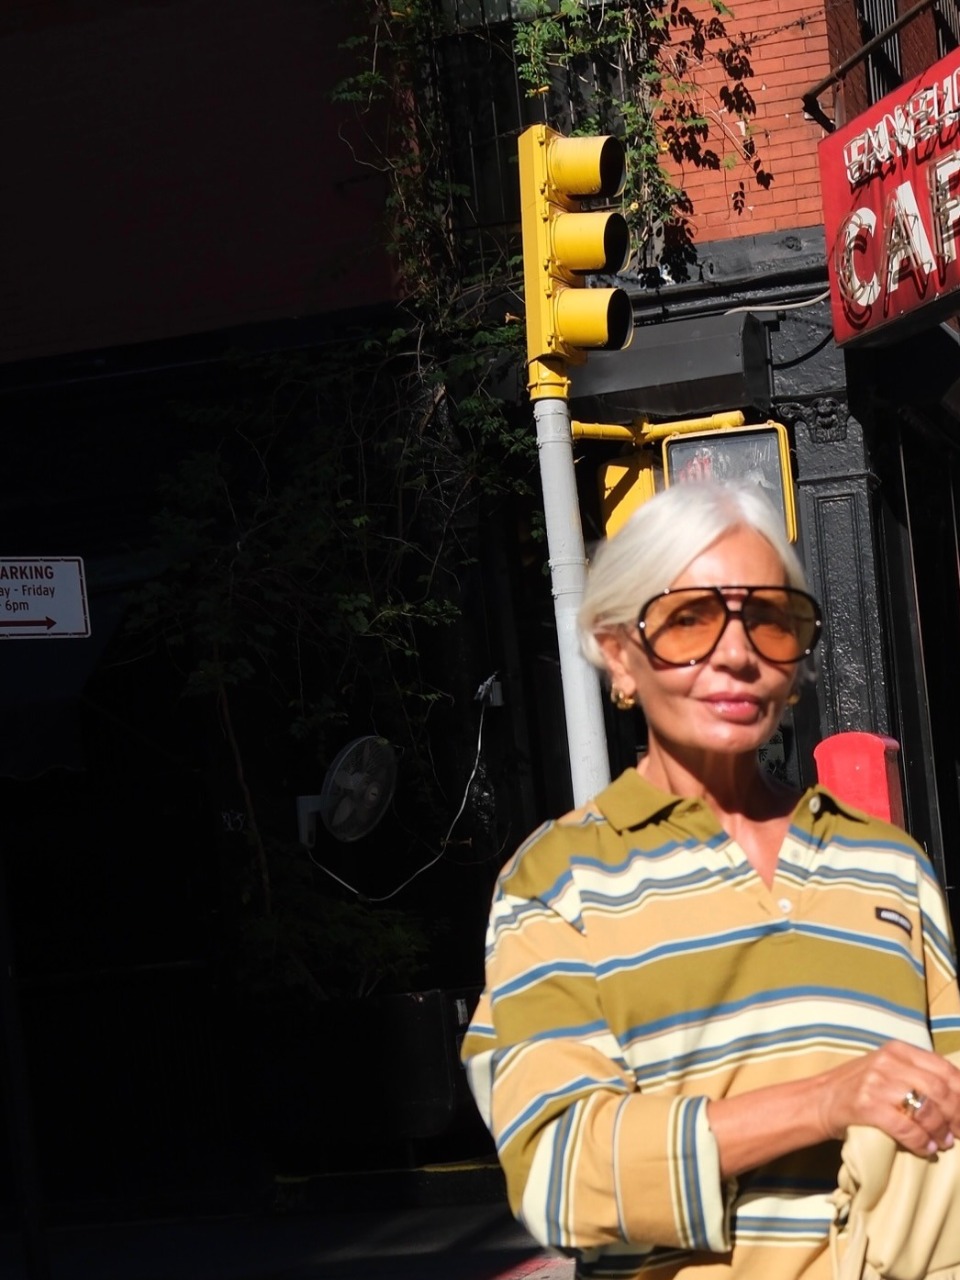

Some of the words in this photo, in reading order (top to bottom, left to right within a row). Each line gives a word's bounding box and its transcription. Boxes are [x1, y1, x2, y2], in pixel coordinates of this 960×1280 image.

[0, 566, 54, 579] ARKING
[22, 585, 55, 598] Friday
[5, 600, 29, 613] 6pm
